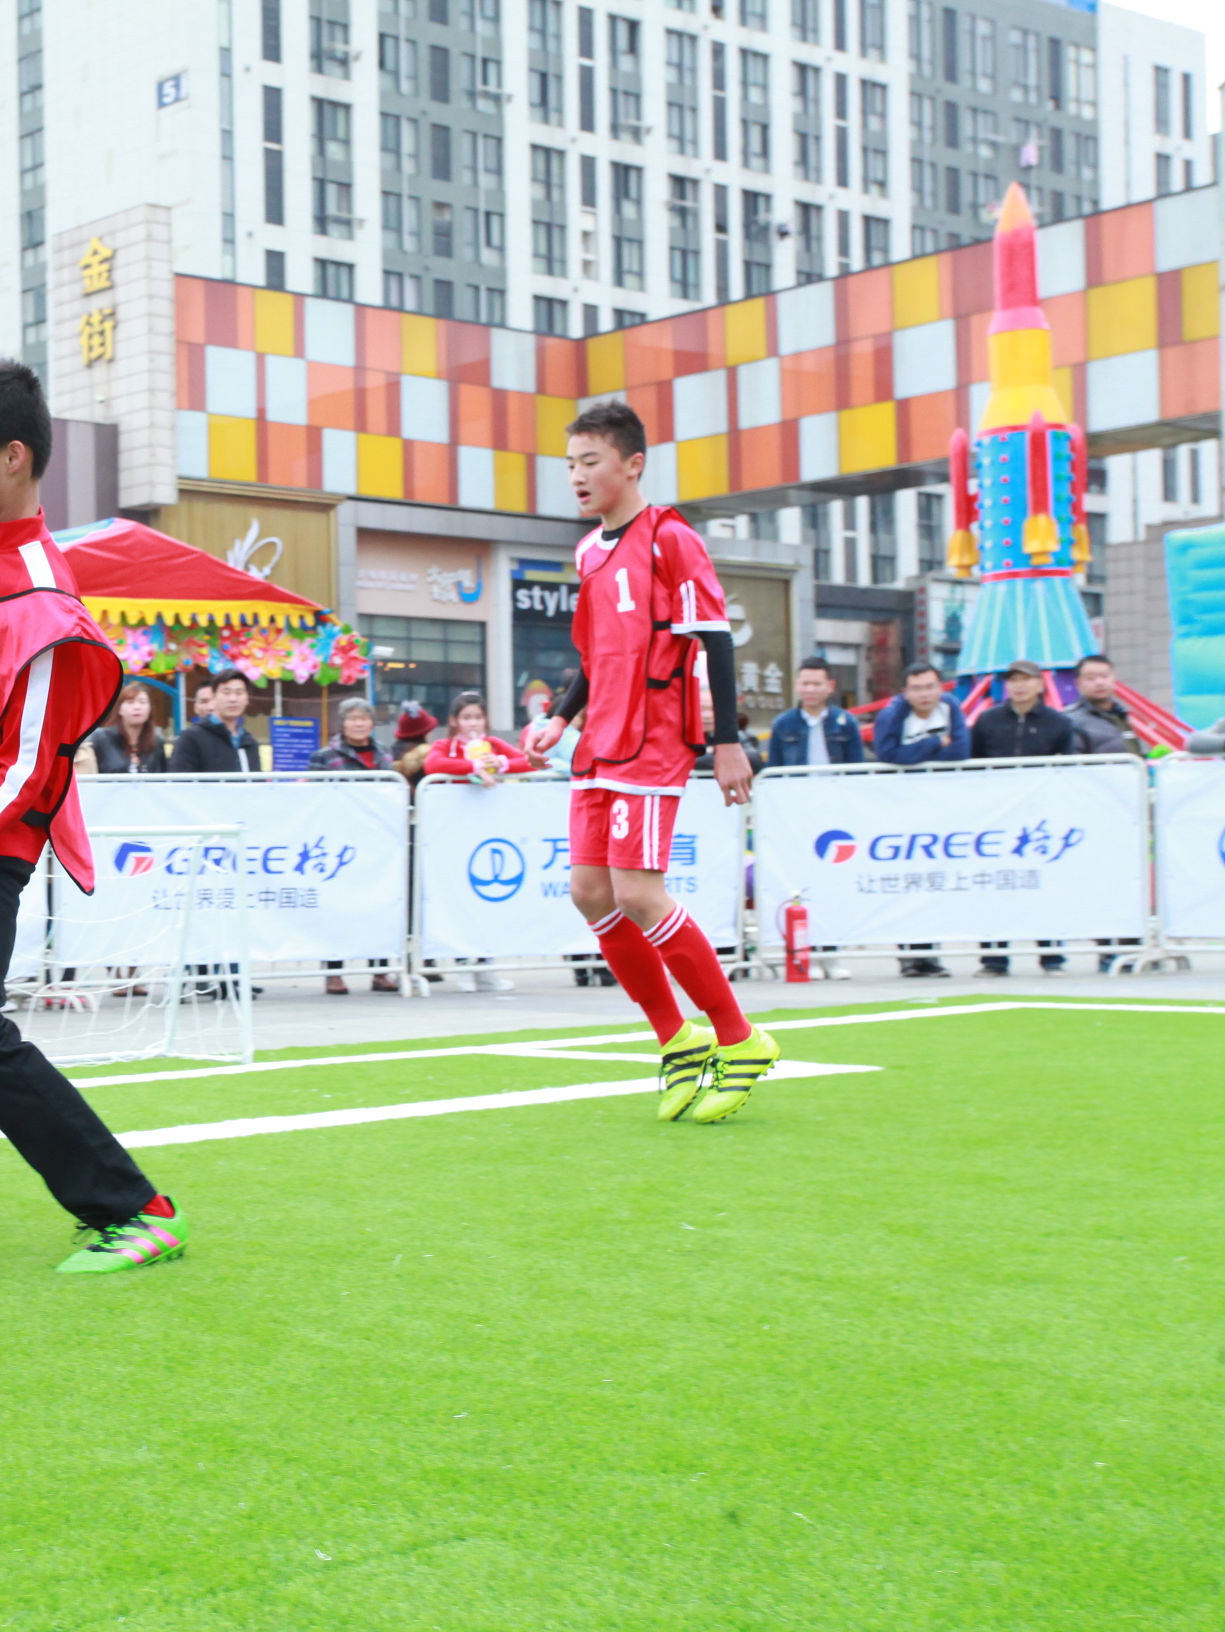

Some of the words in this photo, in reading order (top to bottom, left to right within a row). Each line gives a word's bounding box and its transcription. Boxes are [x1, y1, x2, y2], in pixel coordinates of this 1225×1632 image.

[78, 236, 117, 369] 金街
[614, 567, 636, 613] 1
[736, 662, 784, 693] 黄金
[611, 798, 630, 839] 3
[868, 829, 1007, 861] GREE
[856, 869, 1041, 894] 让世界爱上中国造
